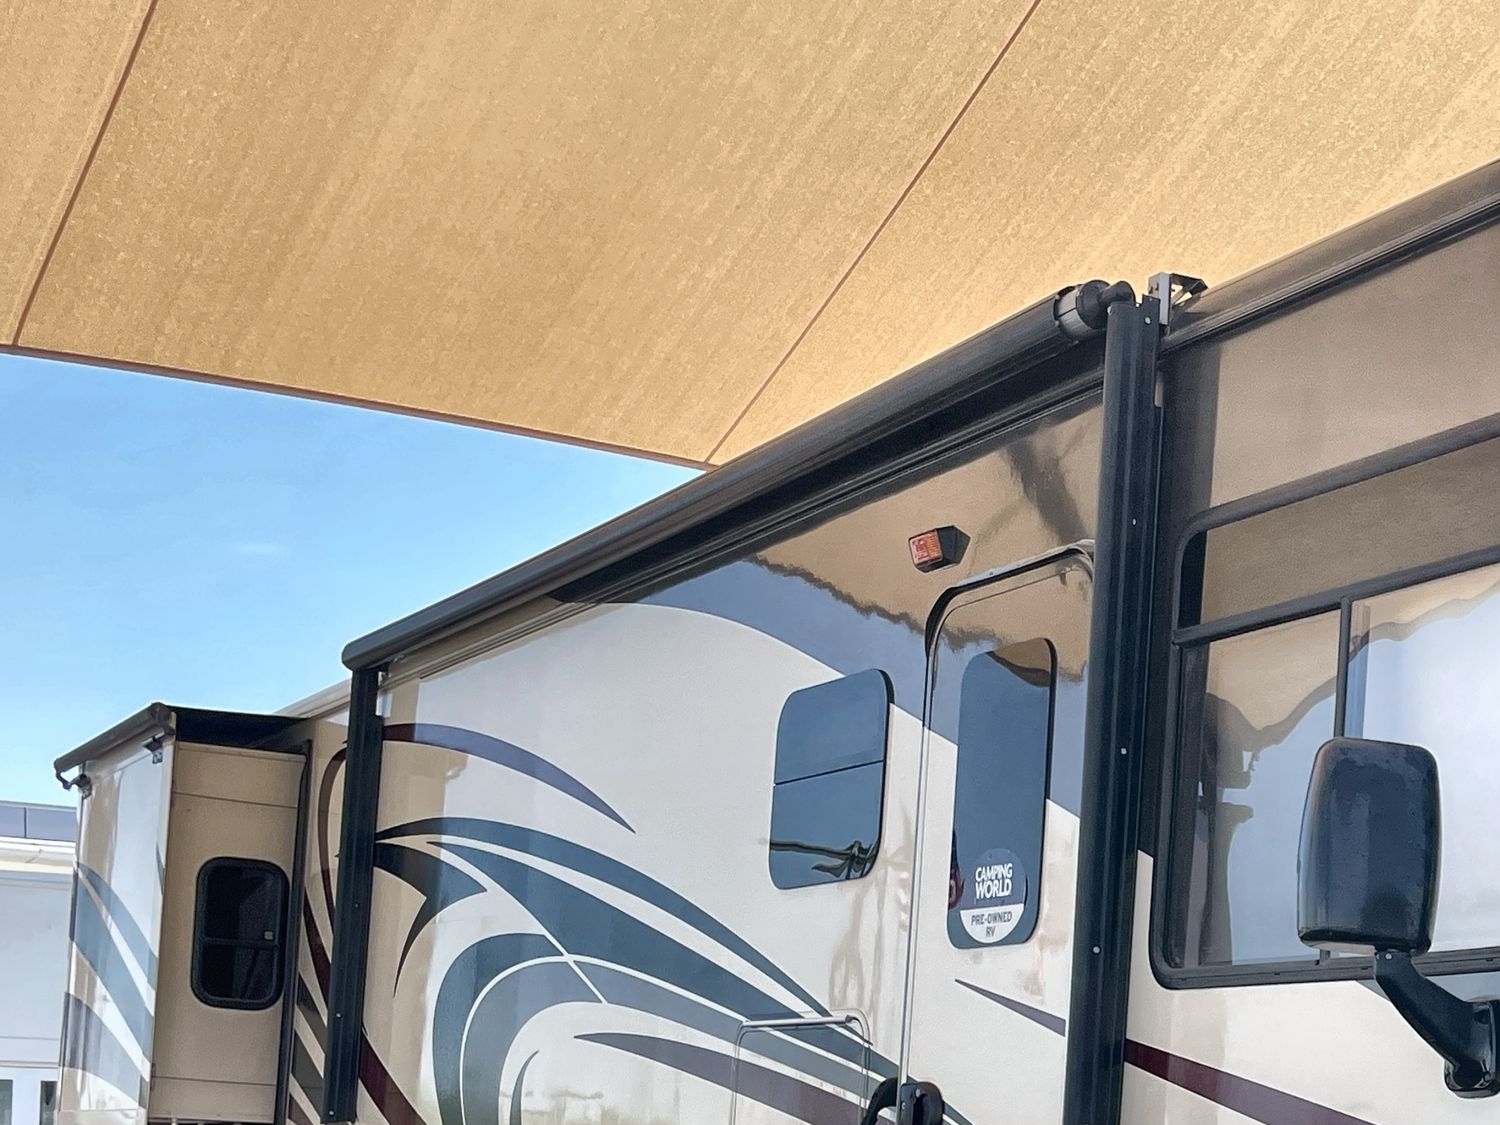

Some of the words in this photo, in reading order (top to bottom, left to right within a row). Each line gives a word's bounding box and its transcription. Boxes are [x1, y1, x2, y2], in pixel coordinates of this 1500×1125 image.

[975, 863, 1013, 882] CAMPING
[975, 879, 1012, 899] WORLD
[971, 911, 1012, 926] PRE-OWNED
[985, 926, 996, 937] RV
